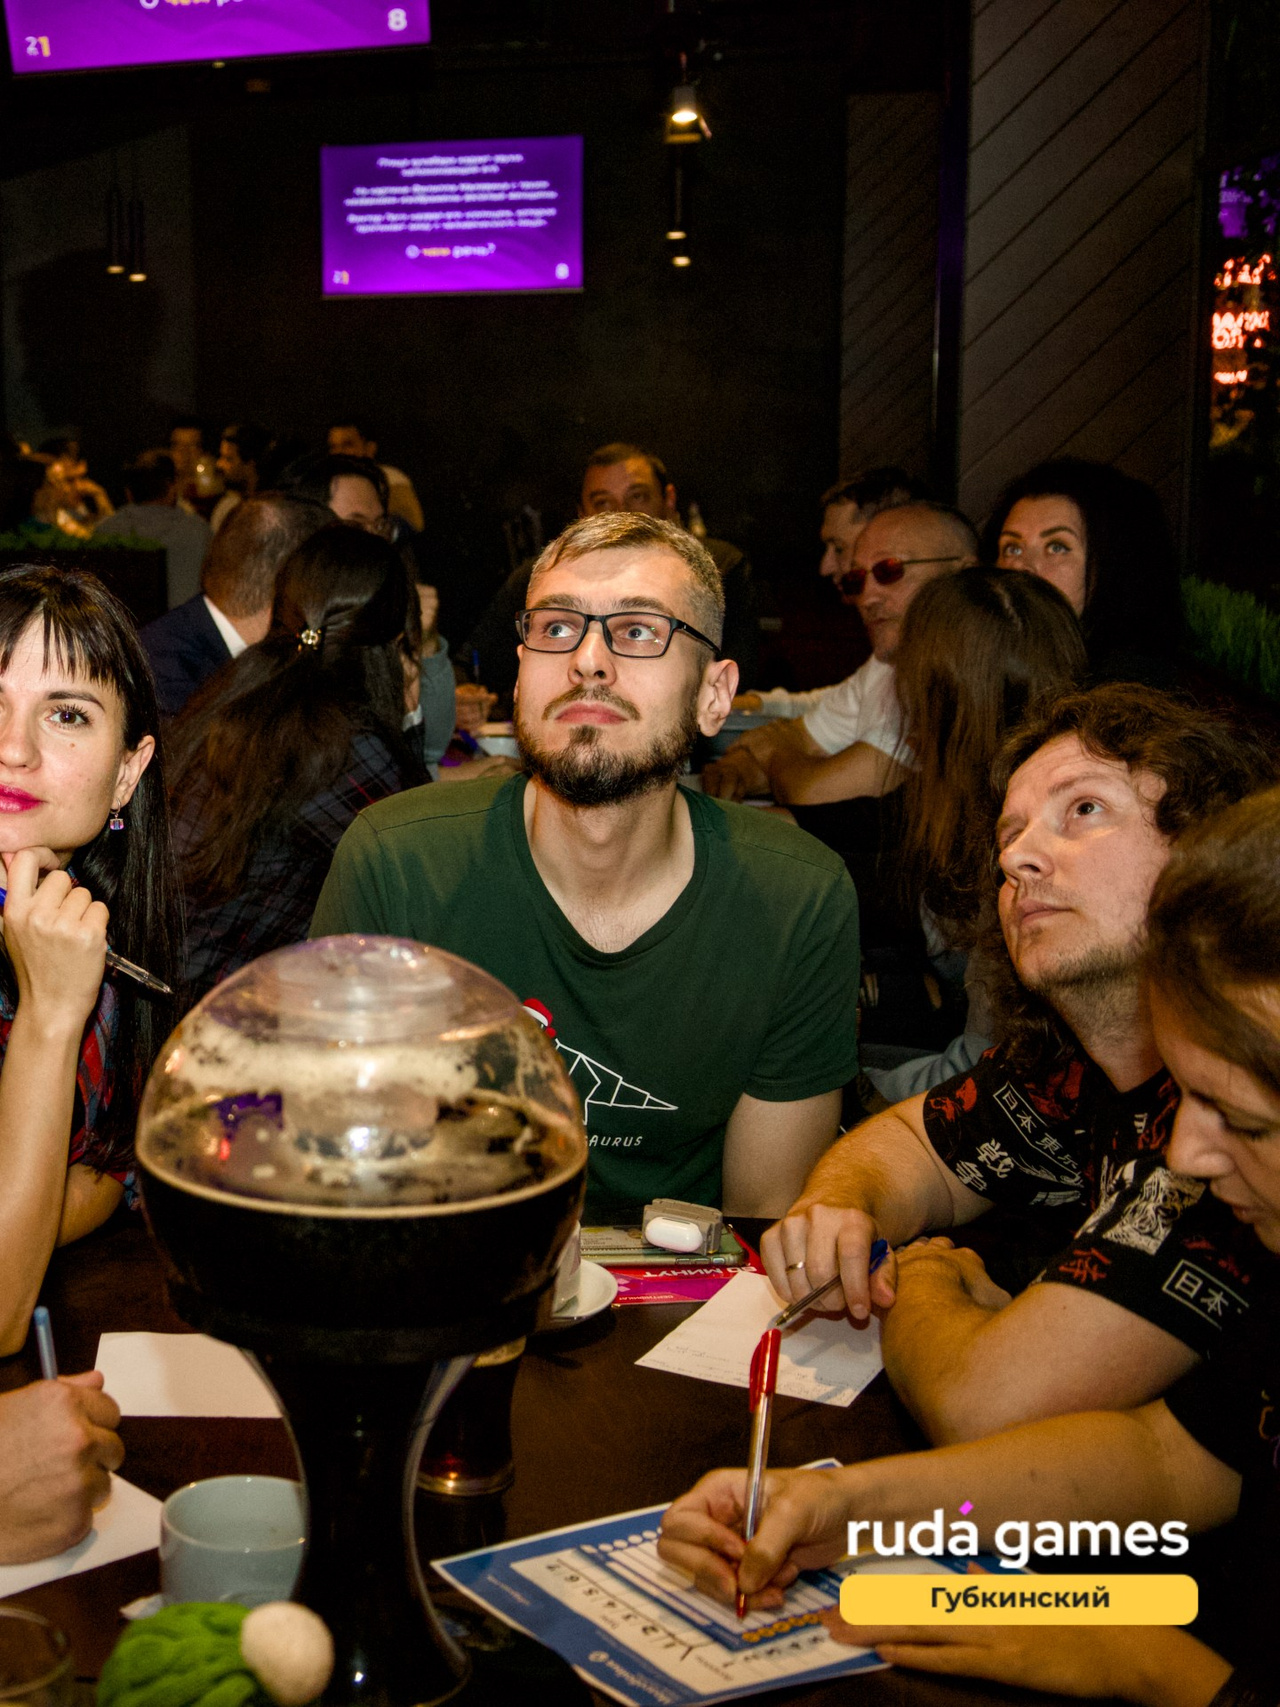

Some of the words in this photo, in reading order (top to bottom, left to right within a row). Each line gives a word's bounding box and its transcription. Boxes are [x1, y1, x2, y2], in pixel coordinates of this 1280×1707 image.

[387, 8, 408, 31] 8
[25, 36, 51, 57] 21
[585, 1134, 643, 1147] AURUS
[643, 1267, 723, 1278] МИНУТ
